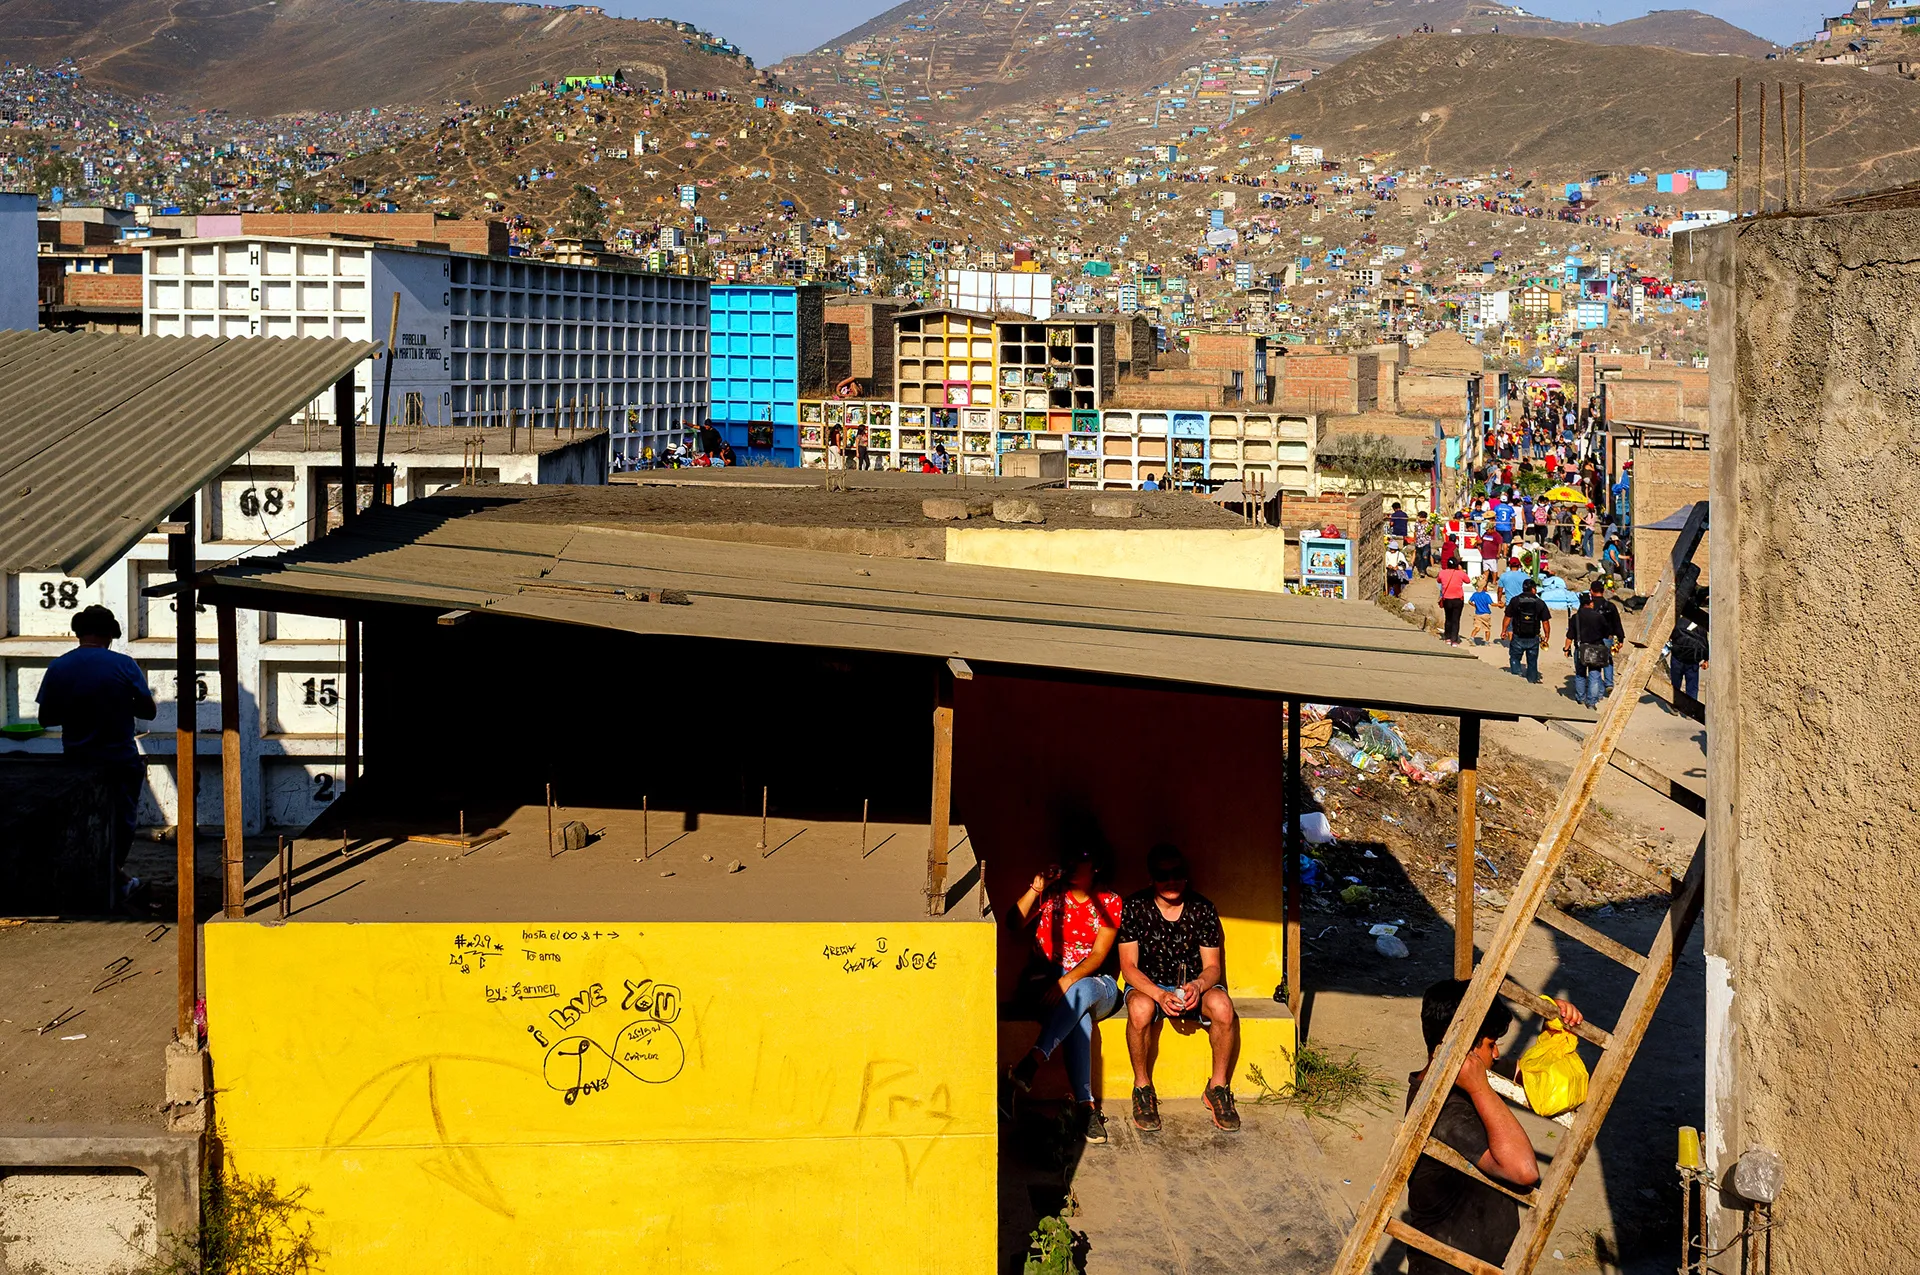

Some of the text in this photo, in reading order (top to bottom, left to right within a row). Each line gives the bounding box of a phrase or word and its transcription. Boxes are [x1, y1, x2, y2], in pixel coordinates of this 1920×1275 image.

[250, 251, 259, 265] H
[443, 263, 450, 277] H
[250, 287, 259, 302] G
[443, 292, 450, 306] G
[250, 321, 259, 335] F
[443, 326, 450, 340] F
[443, 357, 450, 371] E
[444, 392, 450, 406] D
[239, 486, 284, 518] 68
[1501, 511, 1507, 521] 3
[39, 580, 79, 610] 38
[302, 676, 339, 707] 15
[313, 773, 335, 802] 2
[522, 929, 547, 941] hasta
[548, 983, 608, 1031] LOVE
